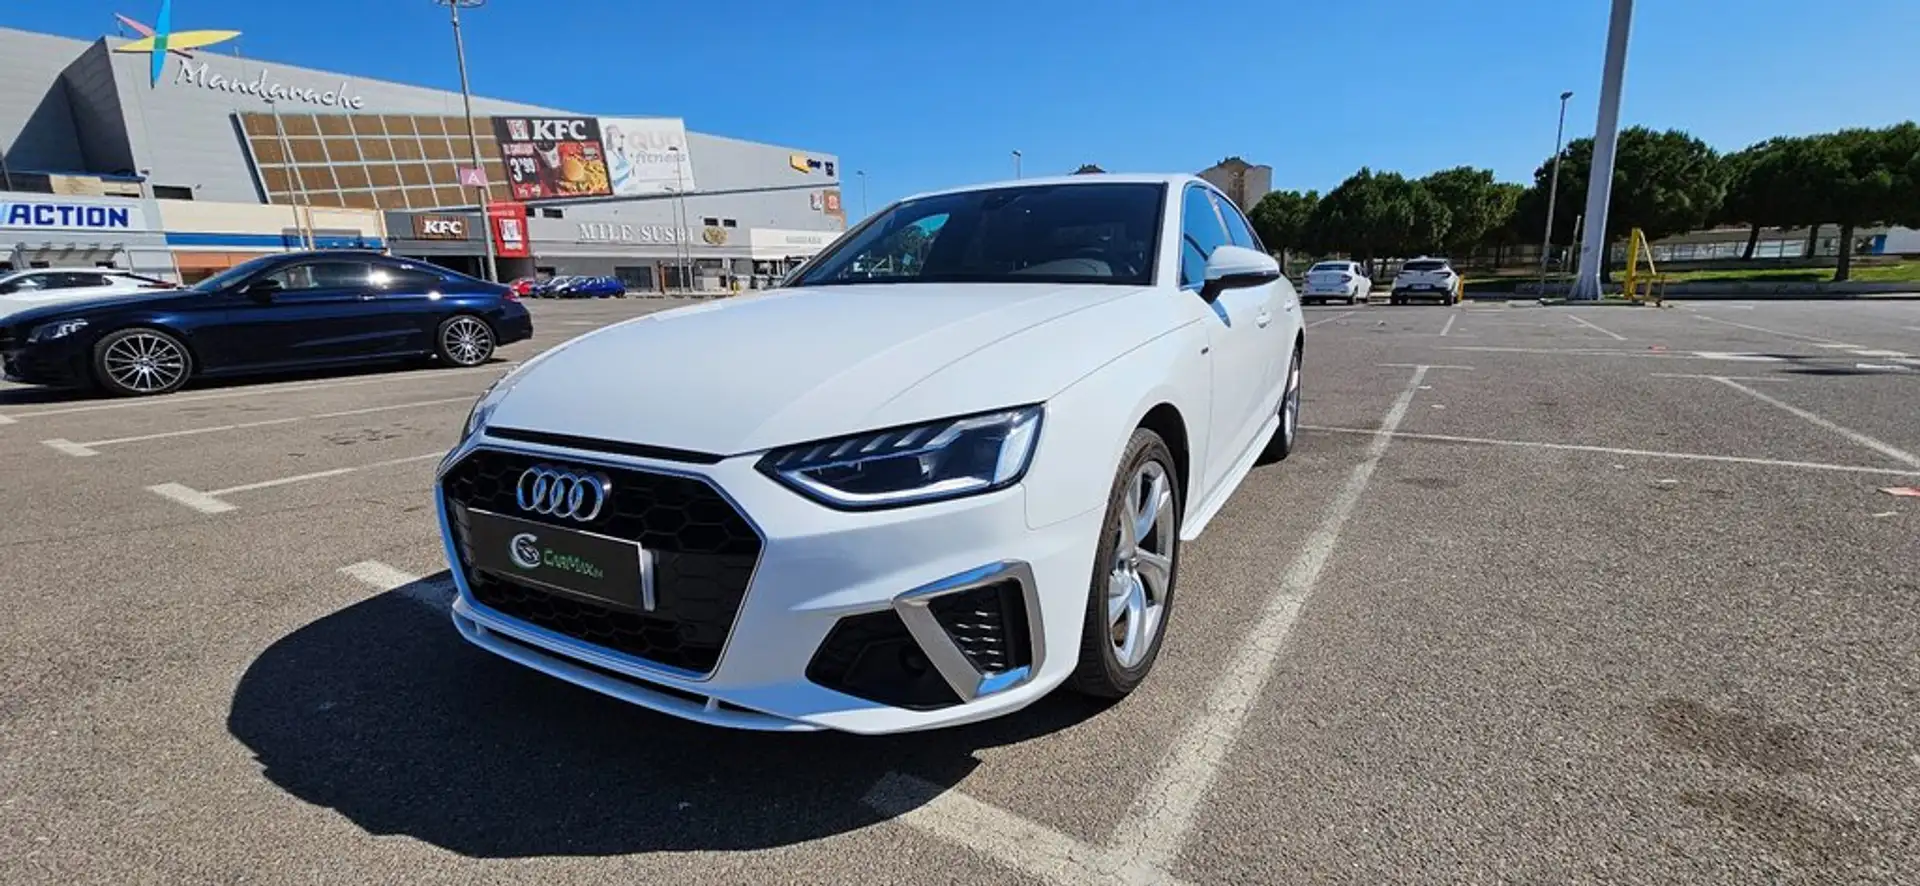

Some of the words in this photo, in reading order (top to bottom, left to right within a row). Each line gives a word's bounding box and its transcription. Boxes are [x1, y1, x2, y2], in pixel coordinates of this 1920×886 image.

[175, 59, 365, 109] Mandarache
[532, 119, 587, 140] KFC
[467, 171, 481, 184] A
[8, 204, 128, 227] ACTION
[424, 220, 463, 235] KFC
[577, 223, 633, 241] MILE
[640, 224, 694, 242] SUSHI
